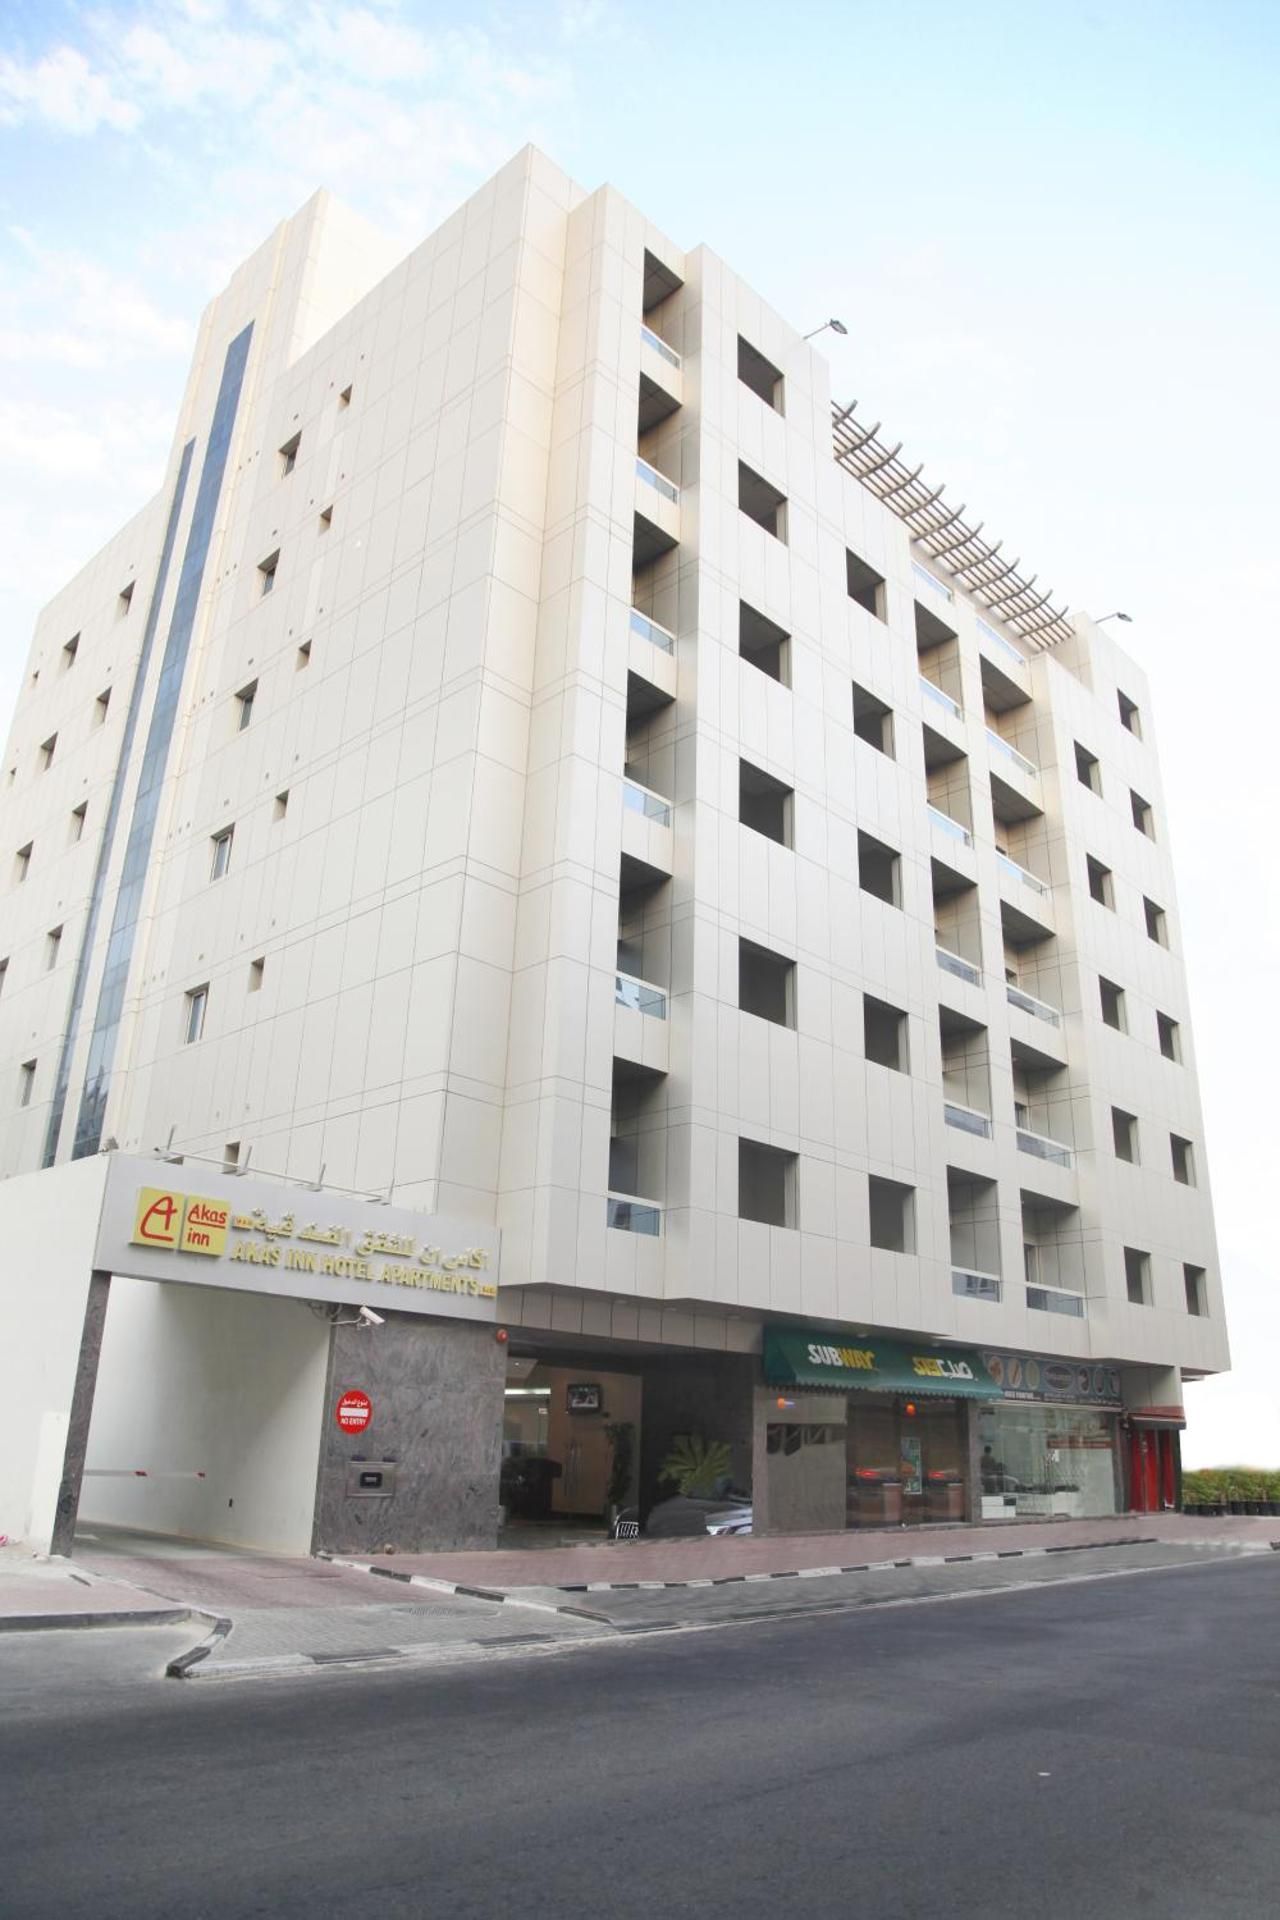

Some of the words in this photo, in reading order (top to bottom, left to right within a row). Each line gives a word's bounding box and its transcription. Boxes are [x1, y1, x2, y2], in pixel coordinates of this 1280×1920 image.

[188, 1204, 227, 1229] Akas
[187, 1227, 210, 1247] inn
[231, 1241, 281, 1267] AKAS
[284, 1248, 318, 1273] INN
[319, 1254, 374, 1282] HOTEL
[378, 1264, 479, 1297] APARTMENTS
[807, 1344, 875, 1371] SUBWAY
[340, 1417, 349, 1425] NO
[349, 1417, 366, 1426] ENTRY
